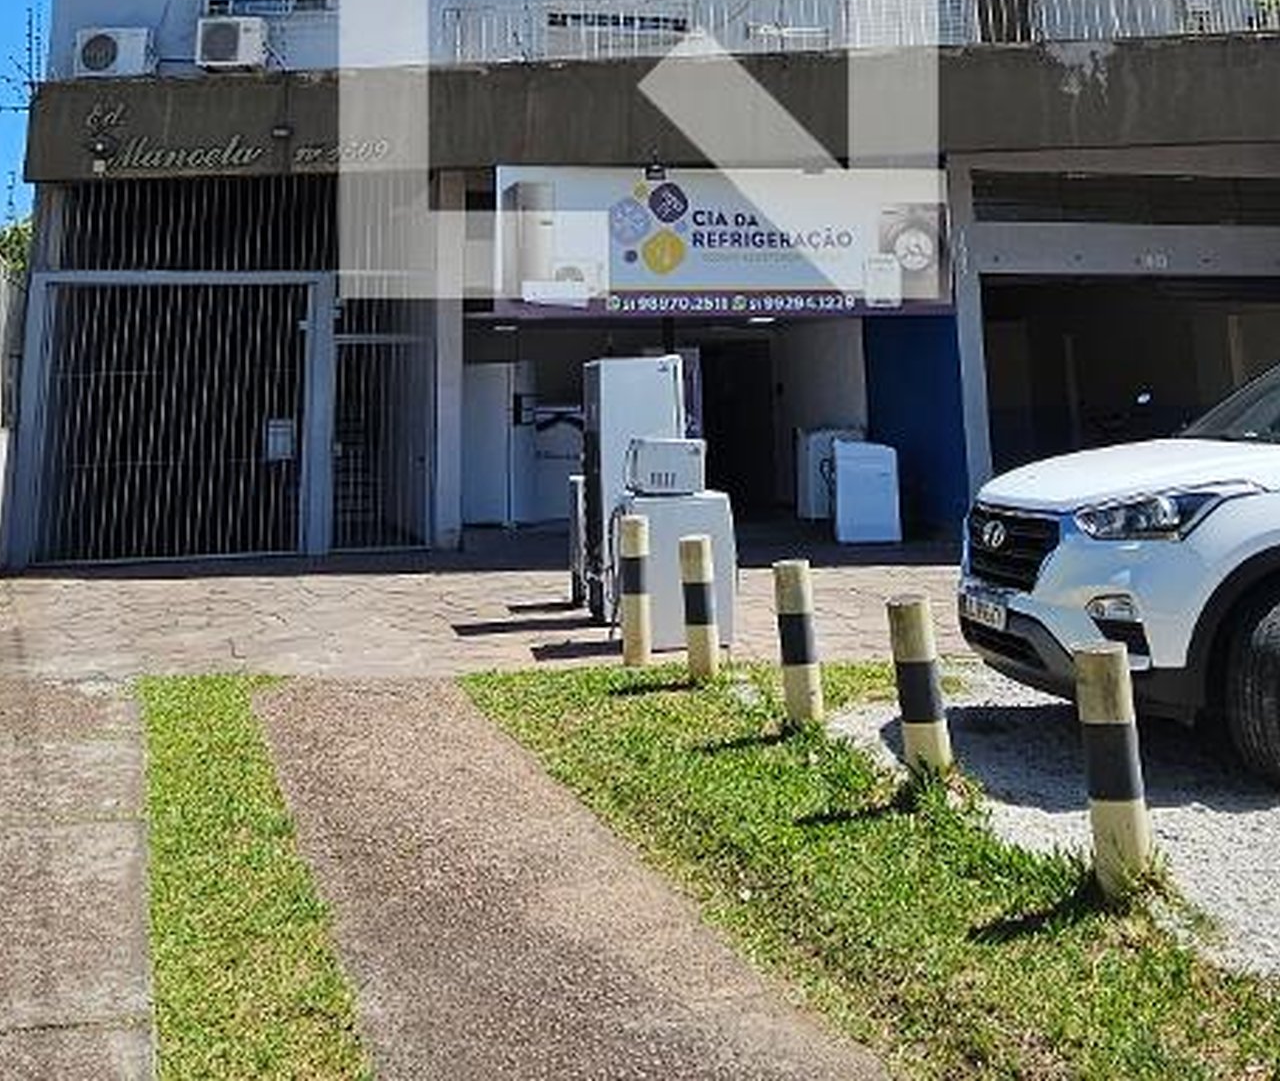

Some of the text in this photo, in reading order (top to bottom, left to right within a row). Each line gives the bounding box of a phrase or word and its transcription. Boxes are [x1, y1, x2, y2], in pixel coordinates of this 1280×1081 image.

[692, 210, 760, 227] CIA DA
[692, 227, 853, 251] REFRIGERAÇÃO
